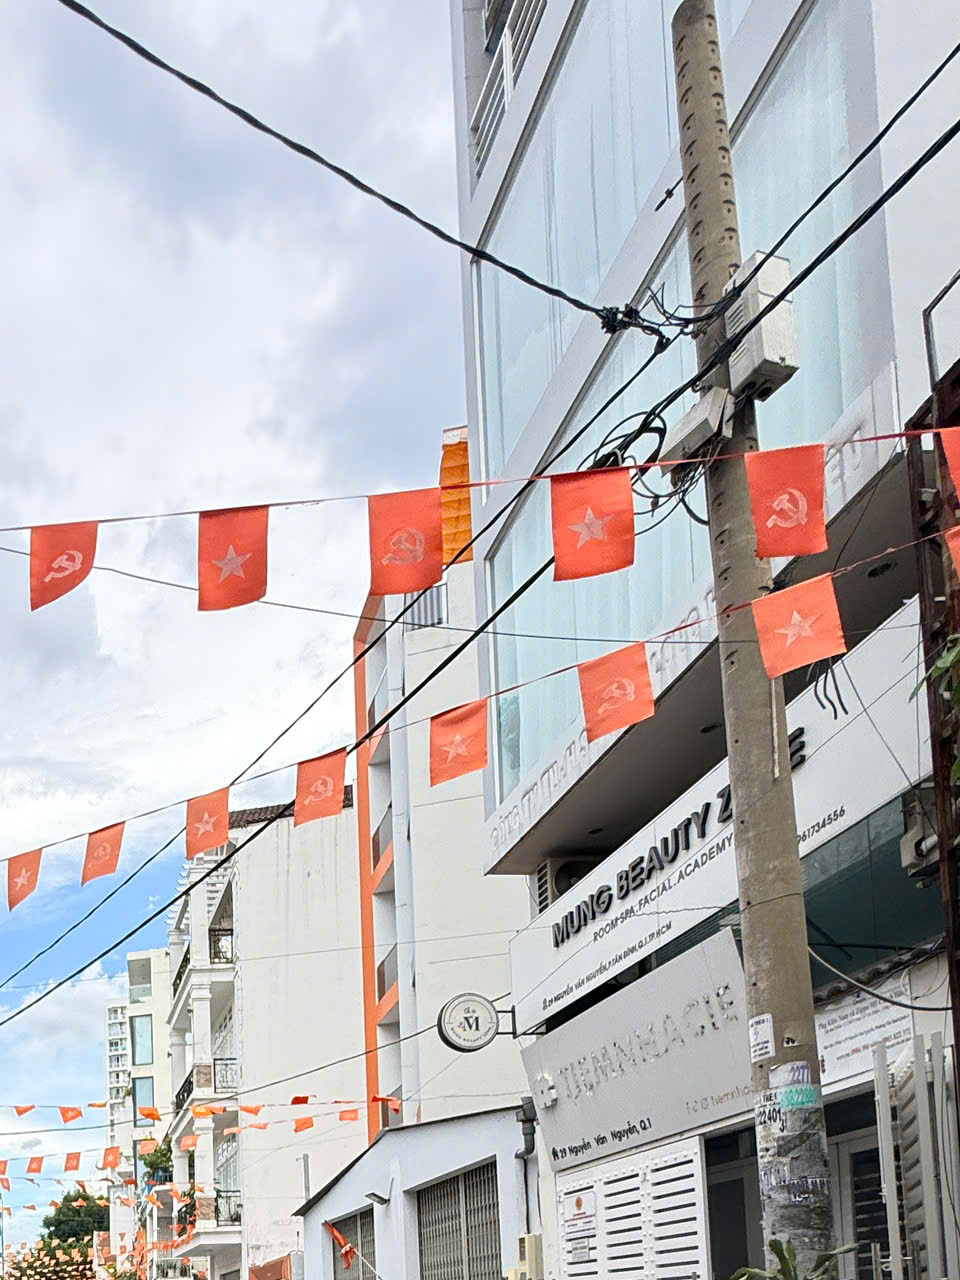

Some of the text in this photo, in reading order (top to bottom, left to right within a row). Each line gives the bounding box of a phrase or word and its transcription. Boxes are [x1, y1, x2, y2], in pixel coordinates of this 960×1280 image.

[797, 805, 845, 844] 961734556
[552, 885, 613, 948] MUNG
[617, 802, 712, 900] BEAUTY
[677, 832, 733, 884] ACADEMY
[559, 1147, 567, 1159] 29
